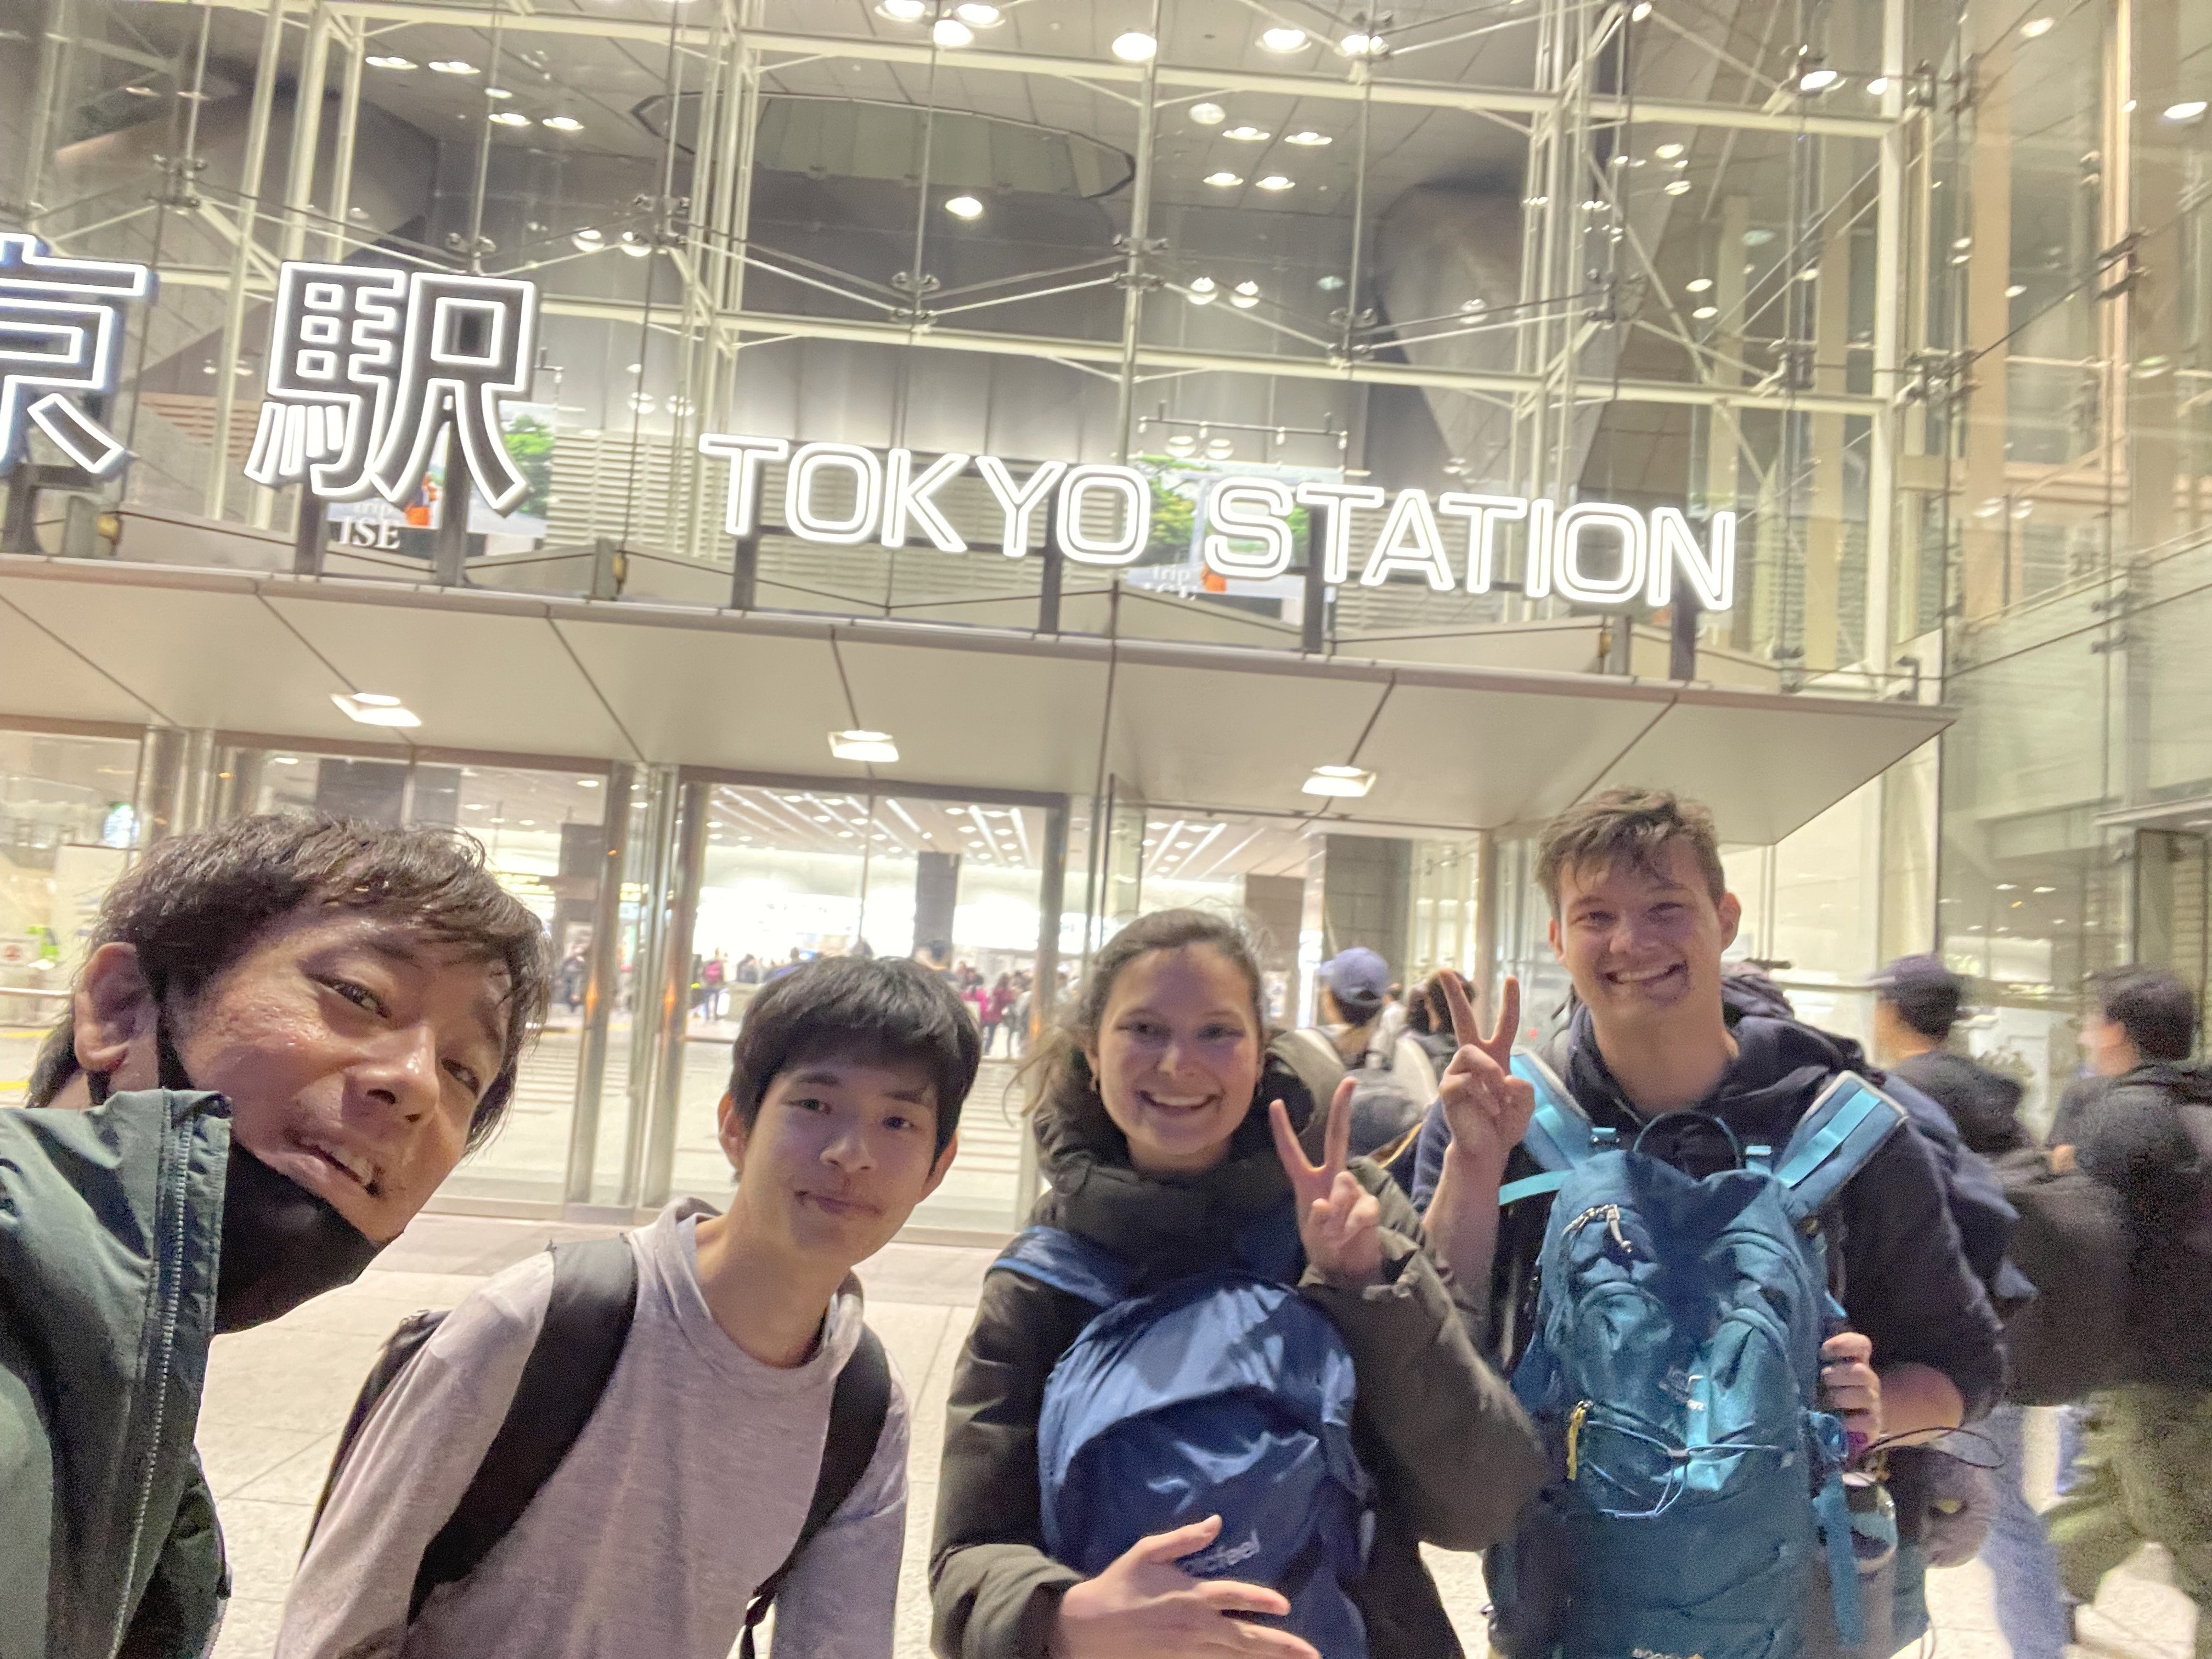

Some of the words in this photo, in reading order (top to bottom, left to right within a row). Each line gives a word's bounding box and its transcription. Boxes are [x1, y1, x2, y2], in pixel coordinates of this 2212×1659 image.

[339, 515, 400, 549] ISE
[698, 433, 1151, 564] TOKYO
[1204, 476, 1736, 610] STATION
